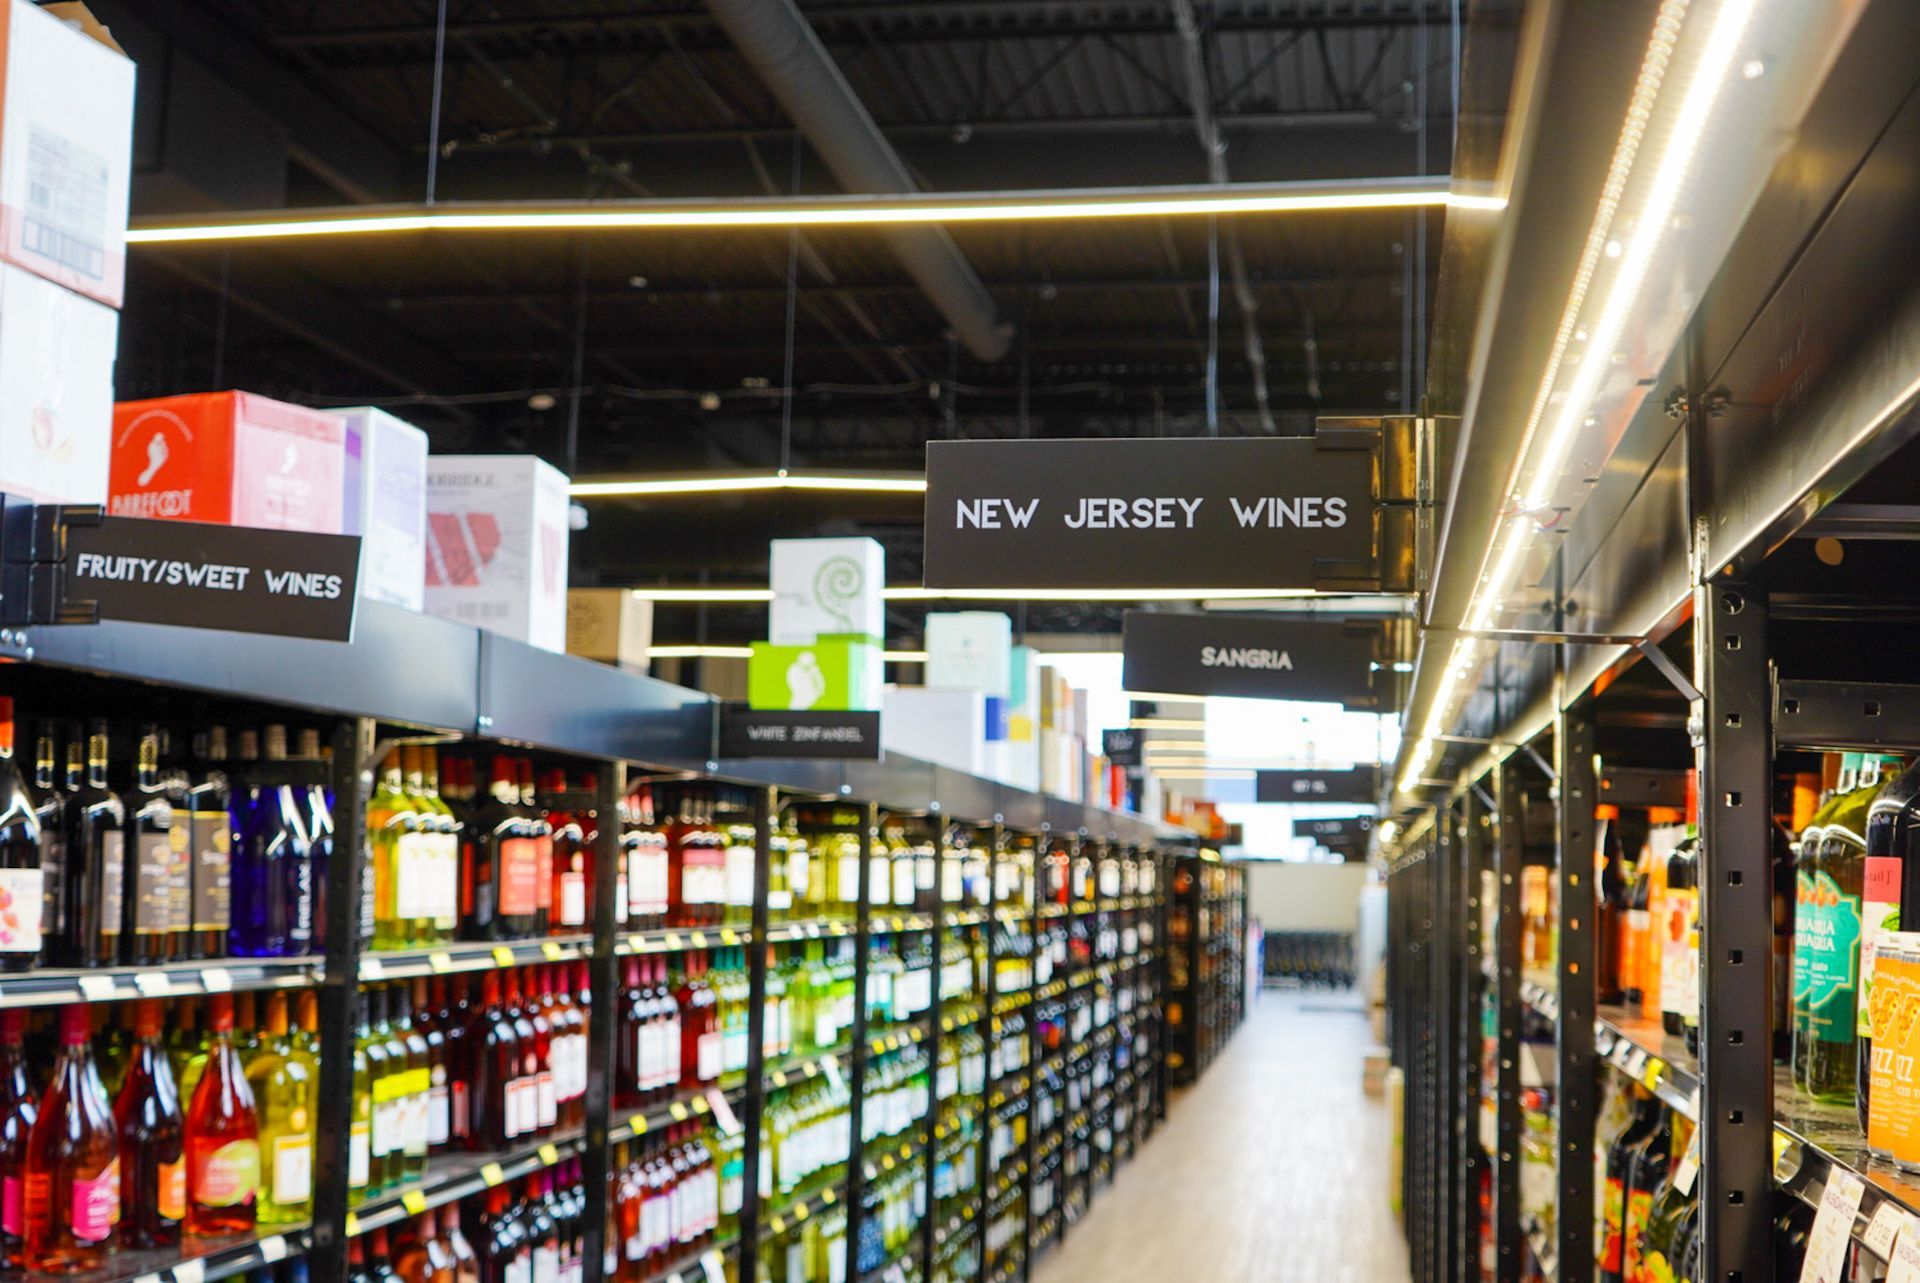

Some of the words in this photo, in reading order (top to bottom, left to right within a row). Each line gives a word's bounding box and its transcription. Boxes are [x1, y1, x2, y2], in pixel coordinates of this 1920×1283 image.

[956, 498, 1039, 529] NEW
[1064, 497, 1203, 529] JERSEY
[1229, 497, 1347, 528] WINES
[76, 552, 249, 591] FRUITY/SWEET
[263, 568, 342, 599] WINES
[1201, 646, 1293, 671] SANGRIA
[747, 726, 786, 742] WHITE
[792, 726, 864, 743] ZINFANDEL
